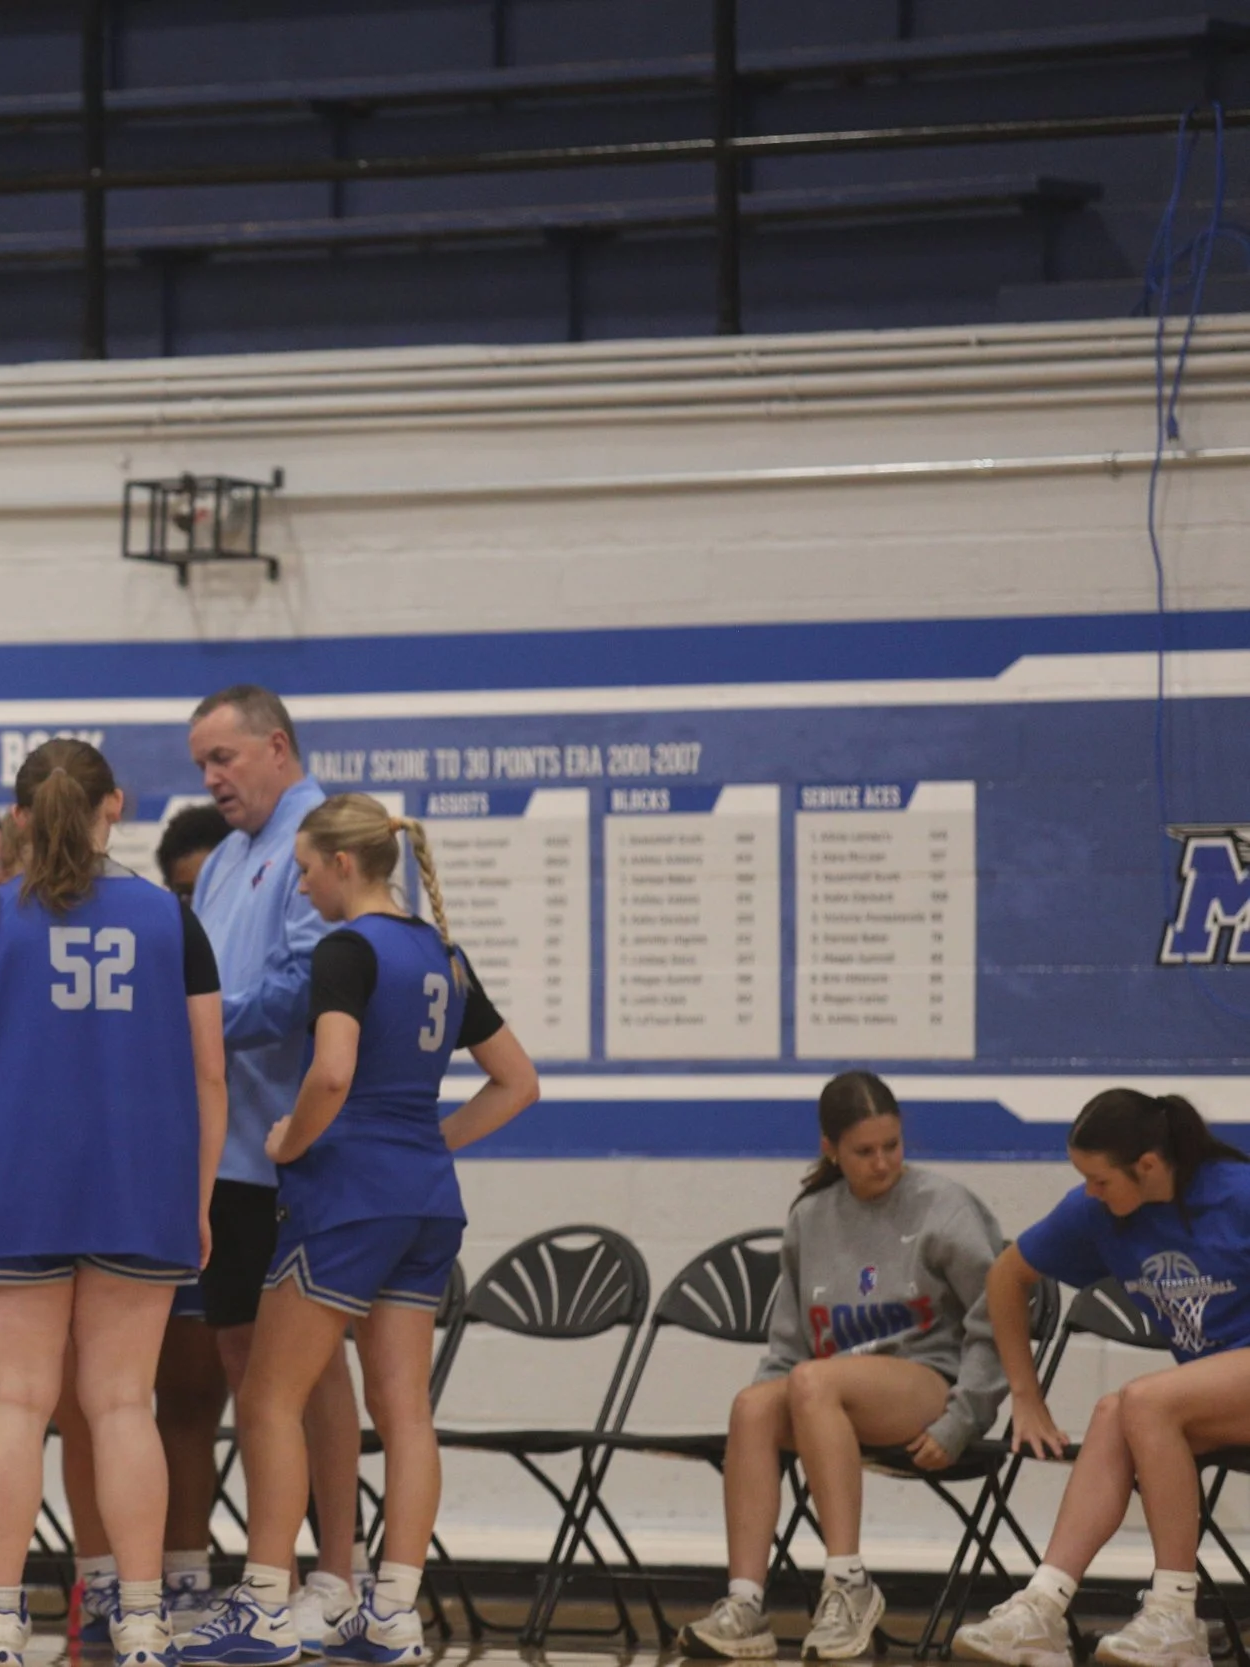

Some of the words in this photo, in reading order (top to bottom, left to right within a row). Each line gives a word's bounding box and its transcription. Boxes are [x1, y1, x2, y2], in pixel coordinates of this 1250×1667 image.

[370, 749, 430, 782] SCORE
[435, 748, 461, 781] TO
[464, 747, 491, 780] 30
[494, 745, 562, 779] POINTS
[49, 926, 137, 1013] 52
[417, 972, 449, 1053] 3
